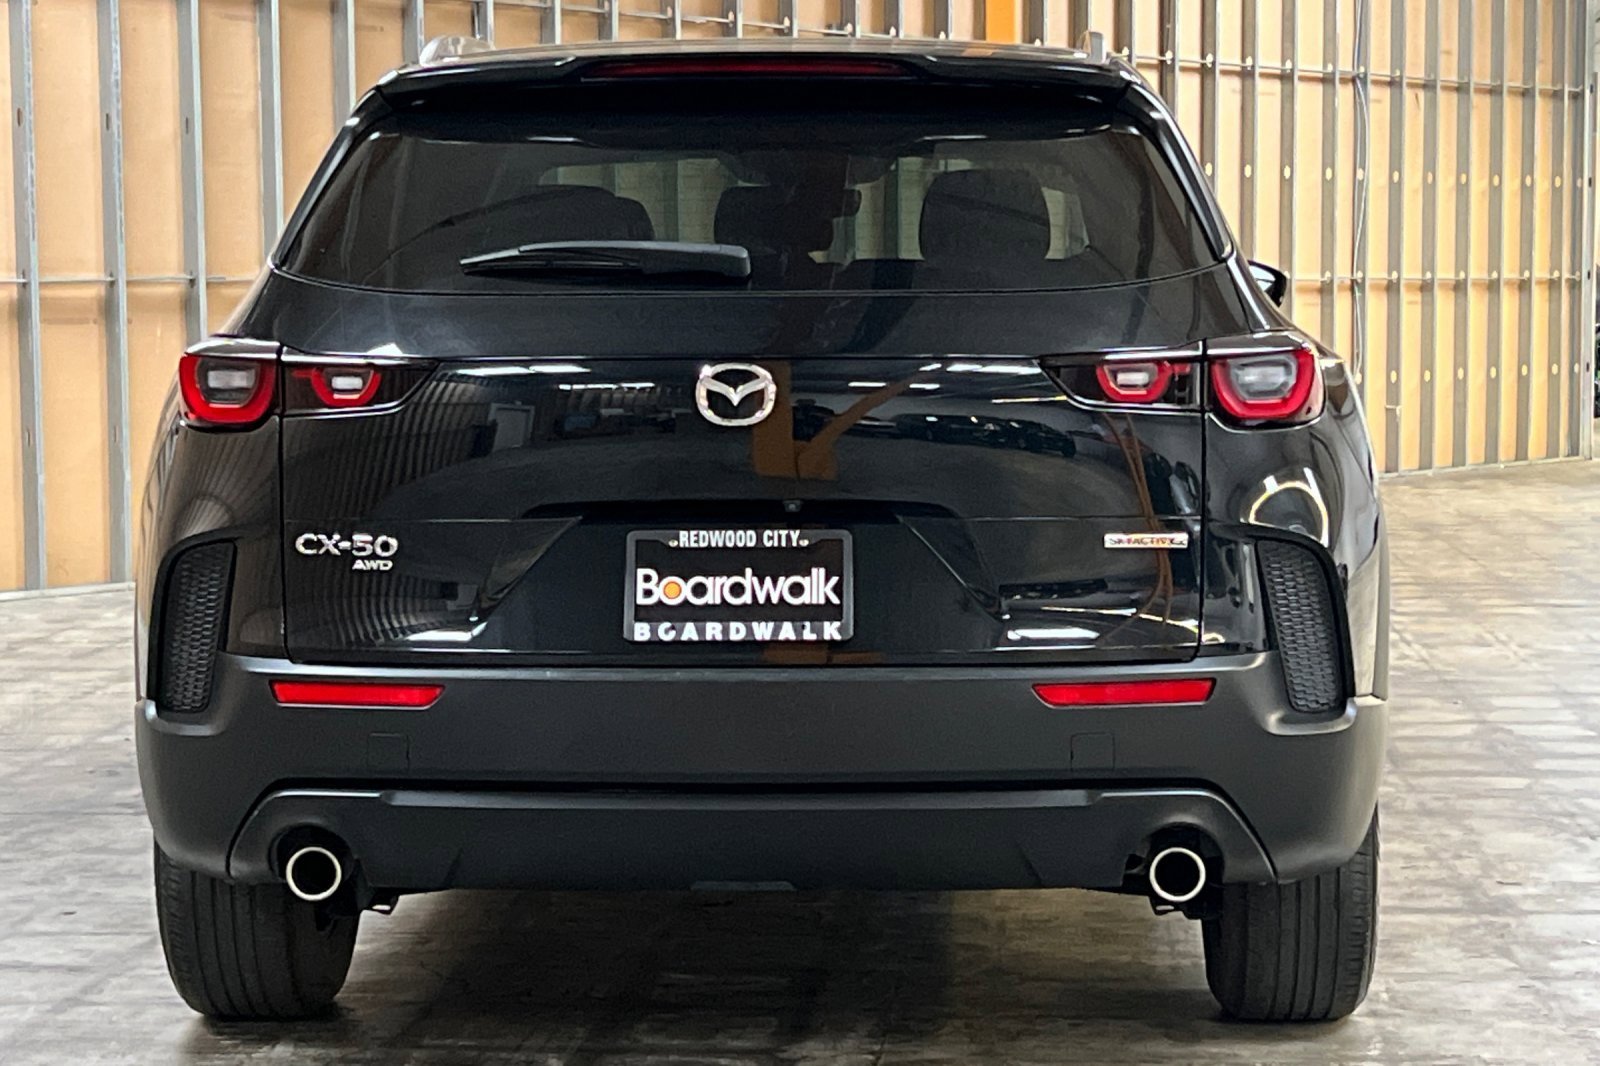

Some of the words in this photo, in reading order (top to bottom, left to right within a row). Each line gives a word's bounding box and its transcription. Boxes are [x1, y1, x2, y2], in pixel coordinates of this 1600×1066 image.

[295, 532, 398, 557] CX-50
[679, 530, 756, 547] REDWOOD
[763, 530, 800, 547] CITY
[352, 559, 393, 571] AWD
[636, 567, 841, 605] Boardwalk
[634, 621, 842, 641] BOARDWALK
